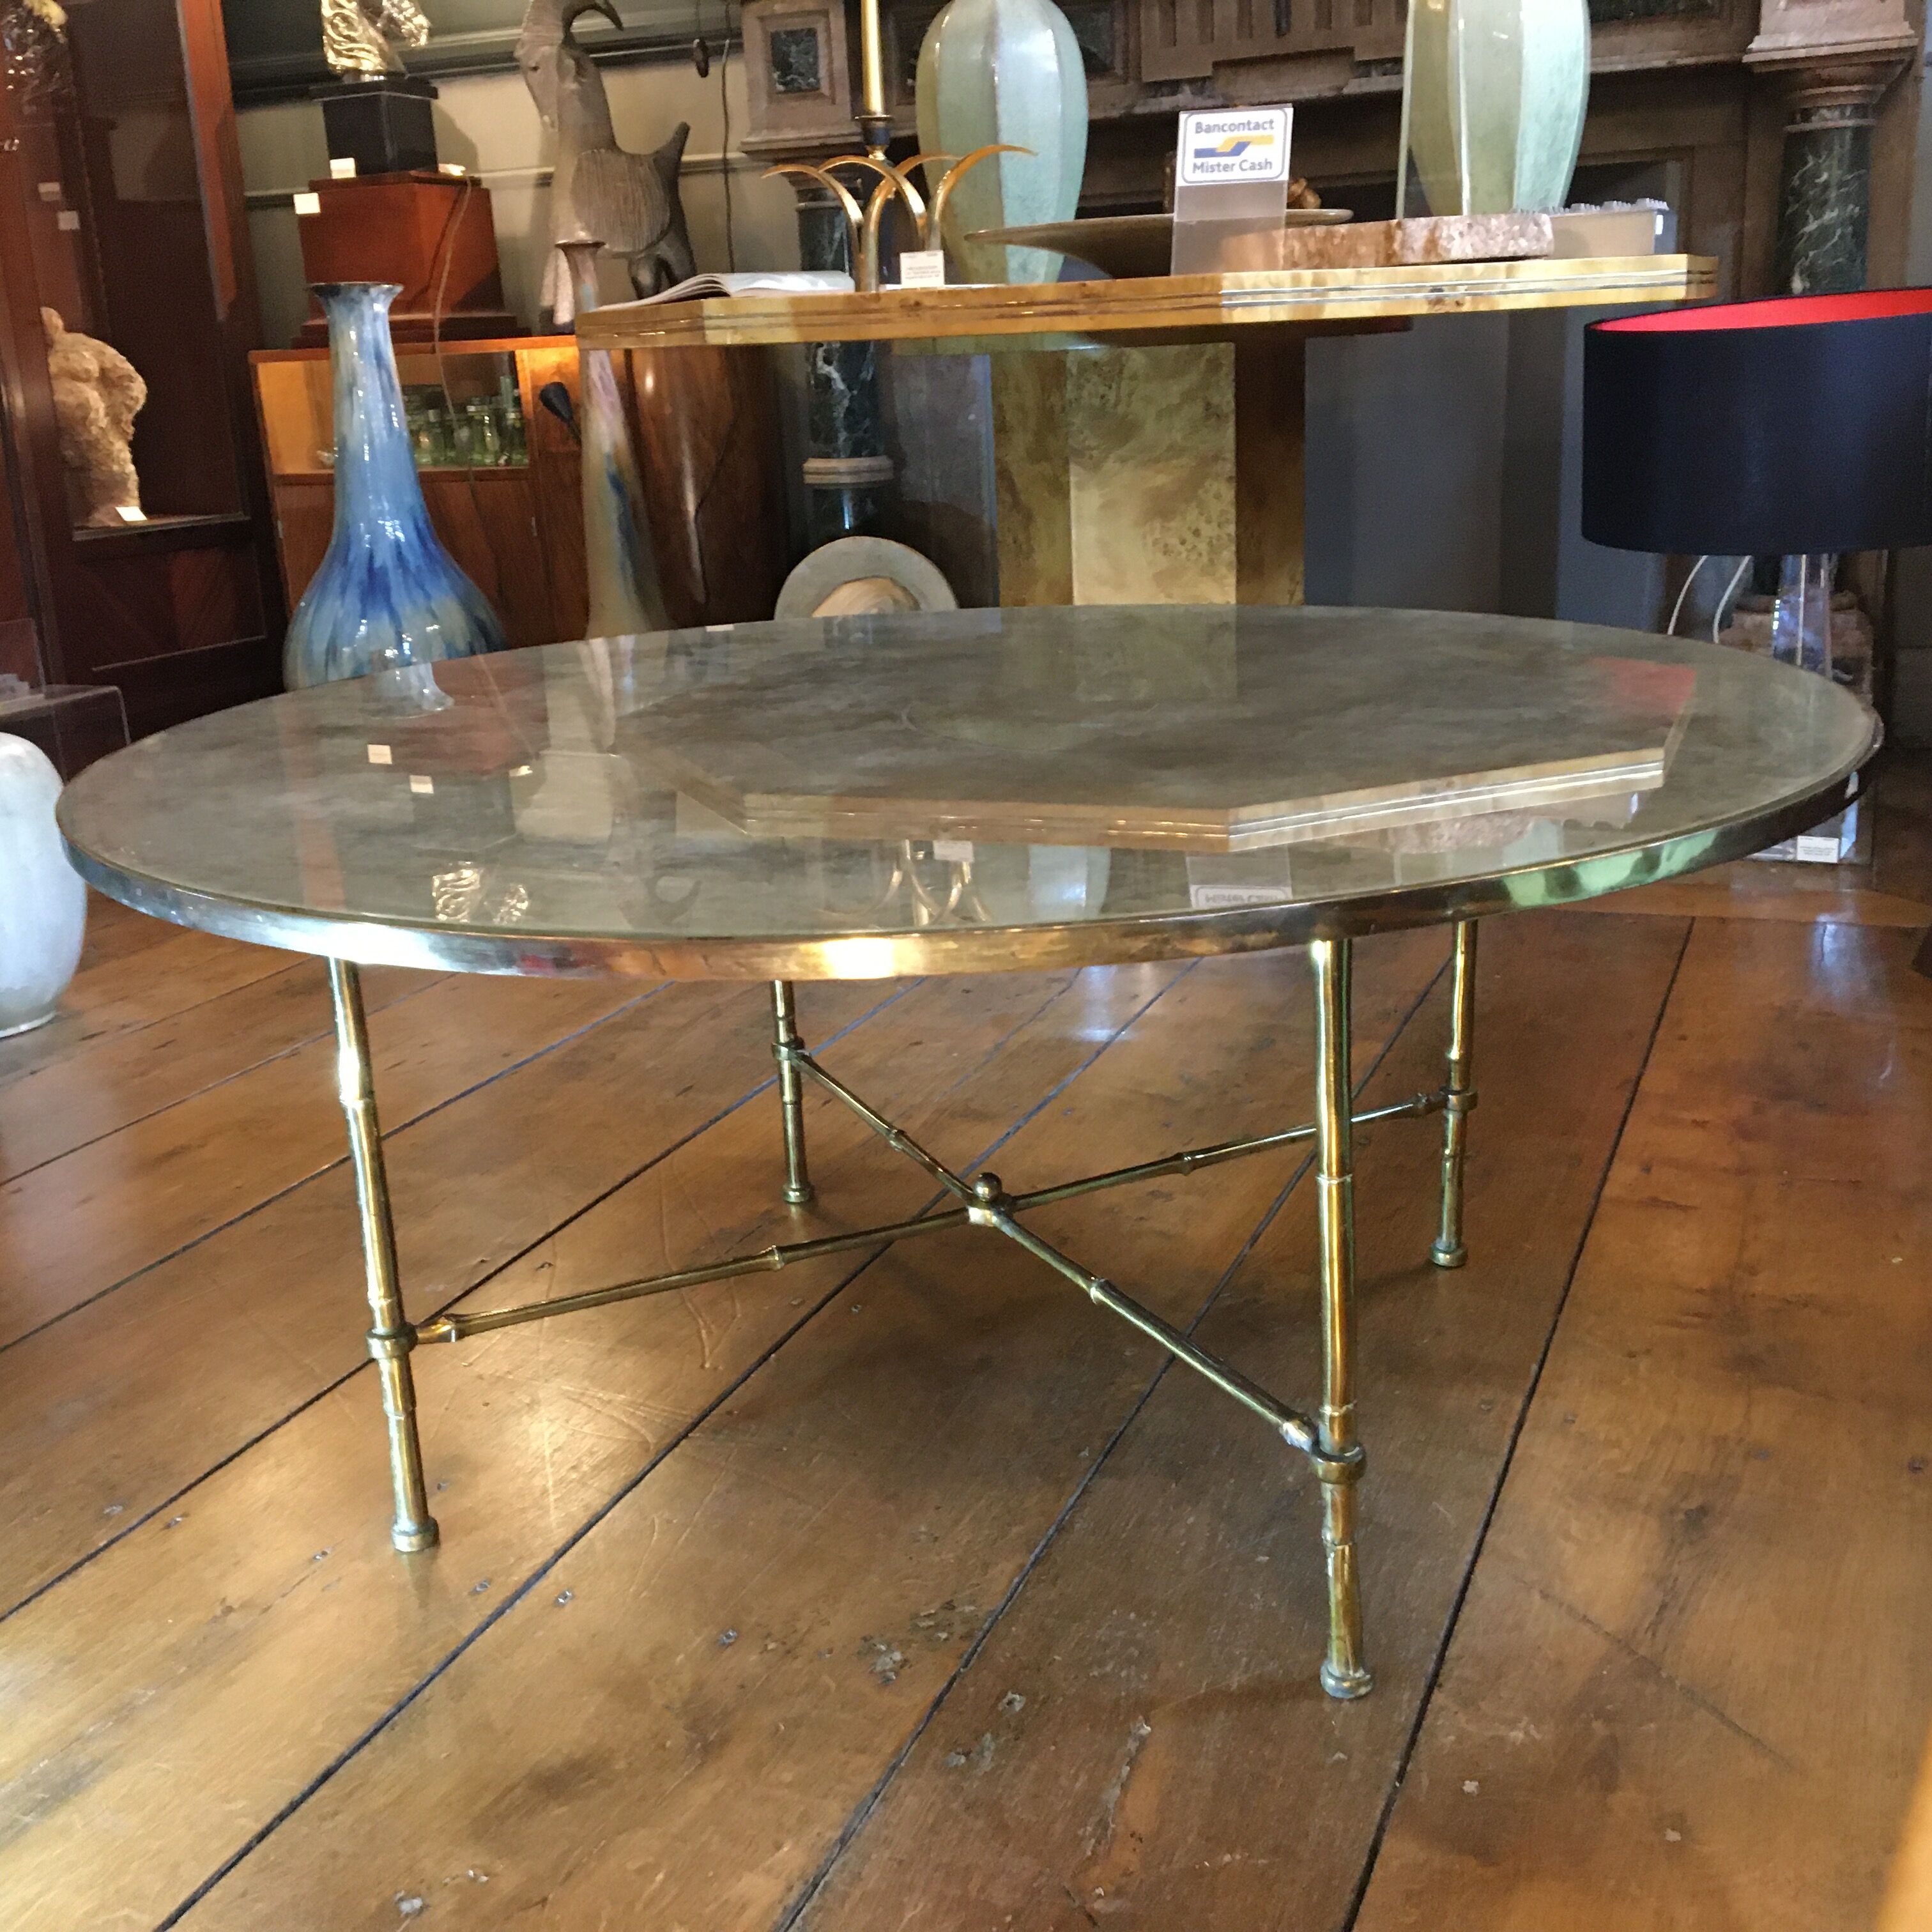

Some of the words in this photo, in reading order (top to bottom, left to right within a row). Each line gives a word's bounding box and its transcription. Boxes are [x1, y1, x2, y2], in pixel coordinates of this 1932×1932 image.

[1195, 119, 1274, 134] Bancontact
[1193, 161, 1236, 174] Mister
[1239, 158, 1272, 172] Cash
